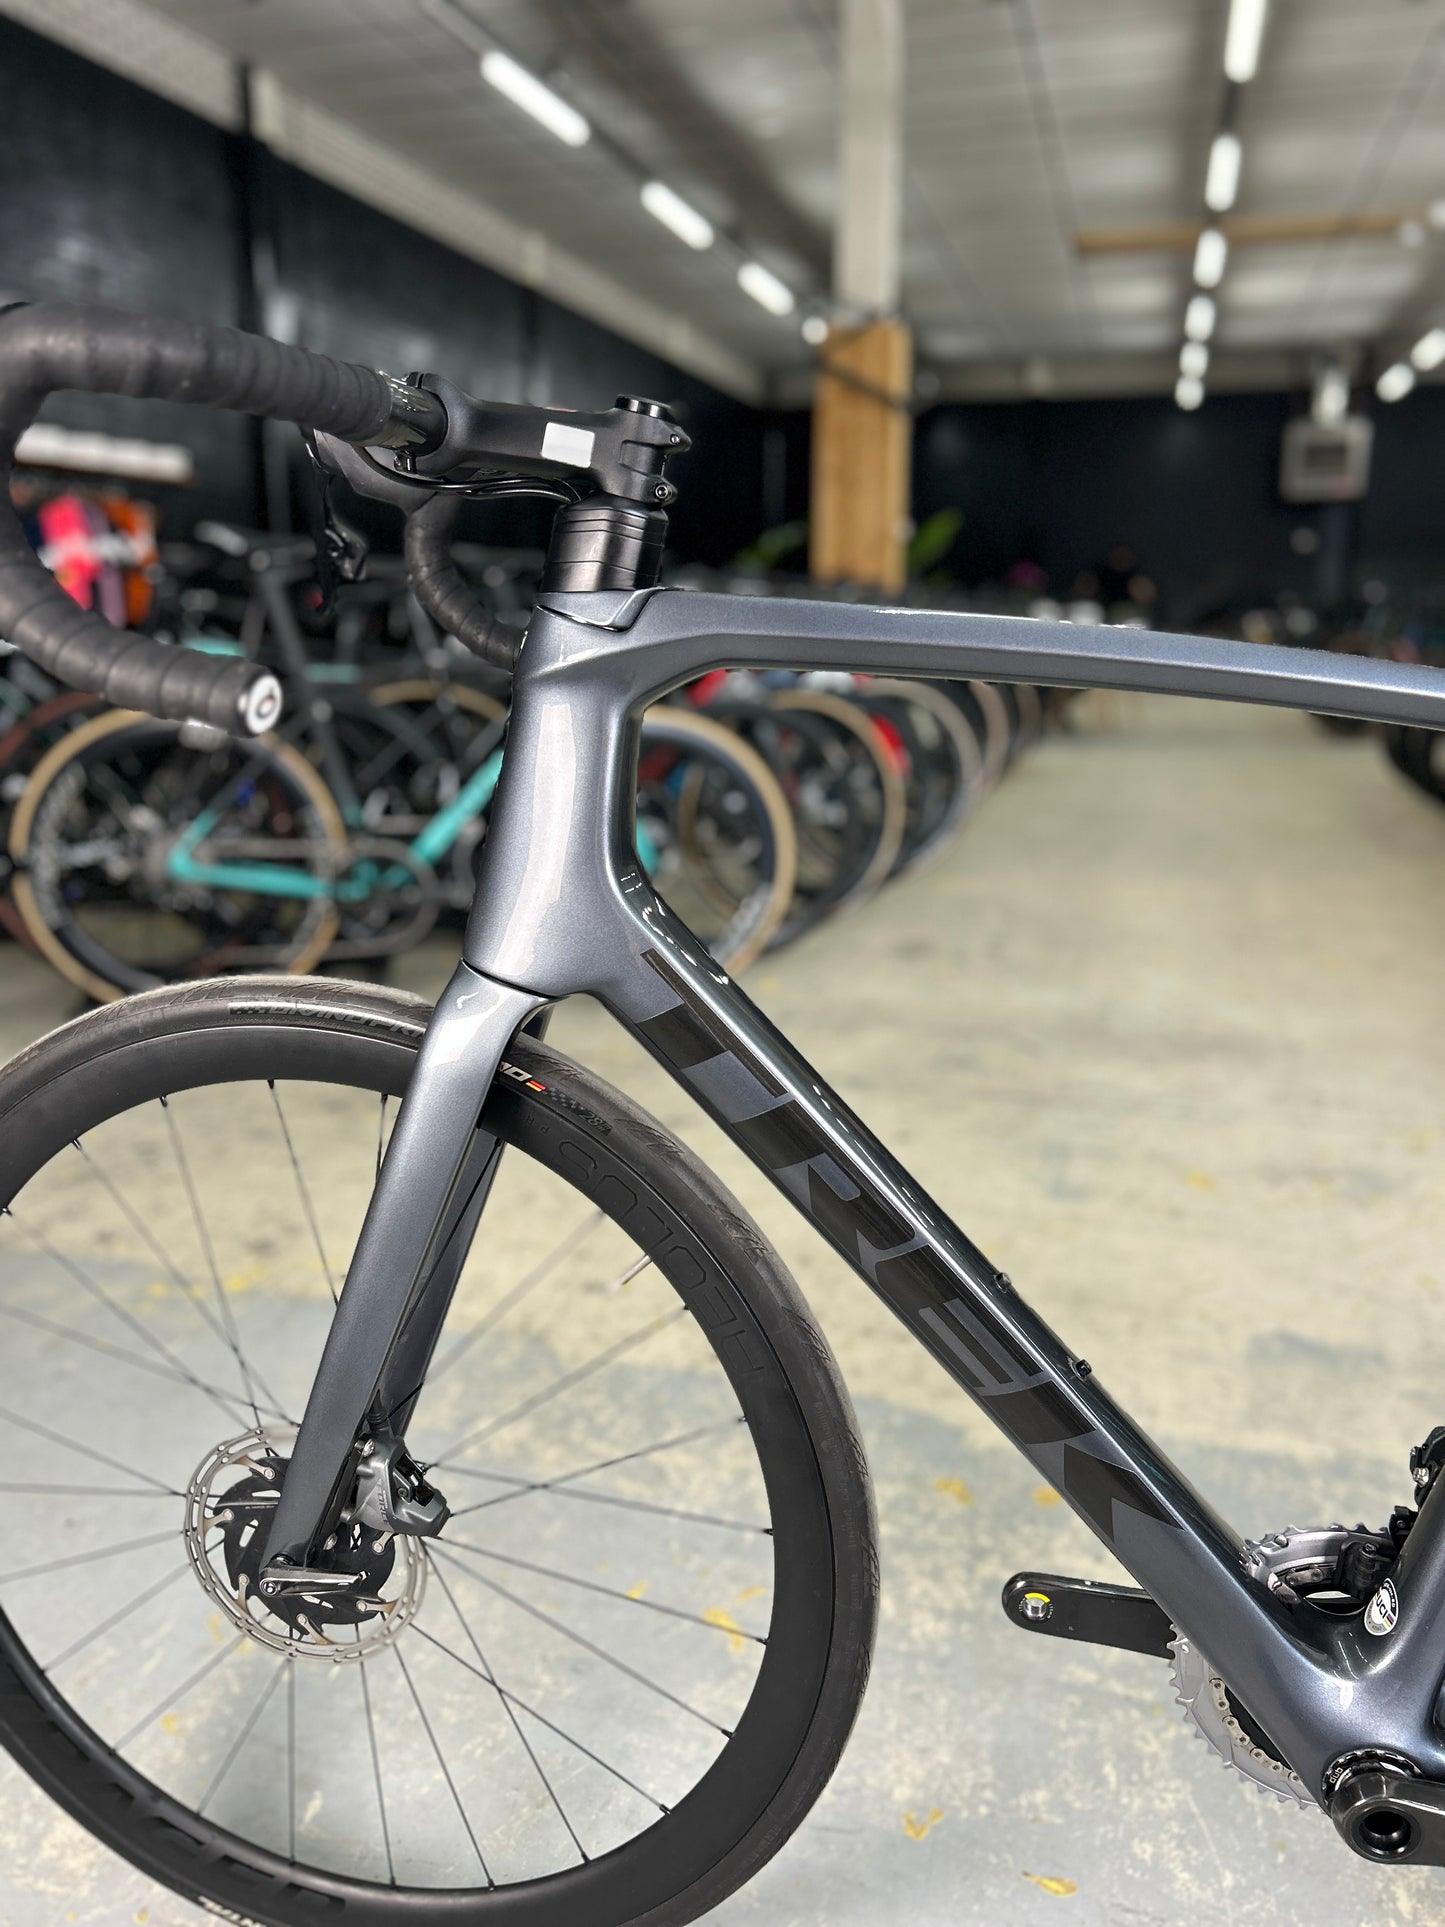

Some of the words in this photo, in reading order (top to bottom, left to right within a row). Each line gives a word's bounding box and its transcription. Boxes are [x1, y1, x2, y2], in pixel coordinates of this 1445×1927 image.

[558, 1139, 766, 1375] AEOLUS
[636, 948, 1187, 1544] TREK
[1375, 1594, 1389, 1619] UCI
[1329, 1767, 1344, 1784] dub
